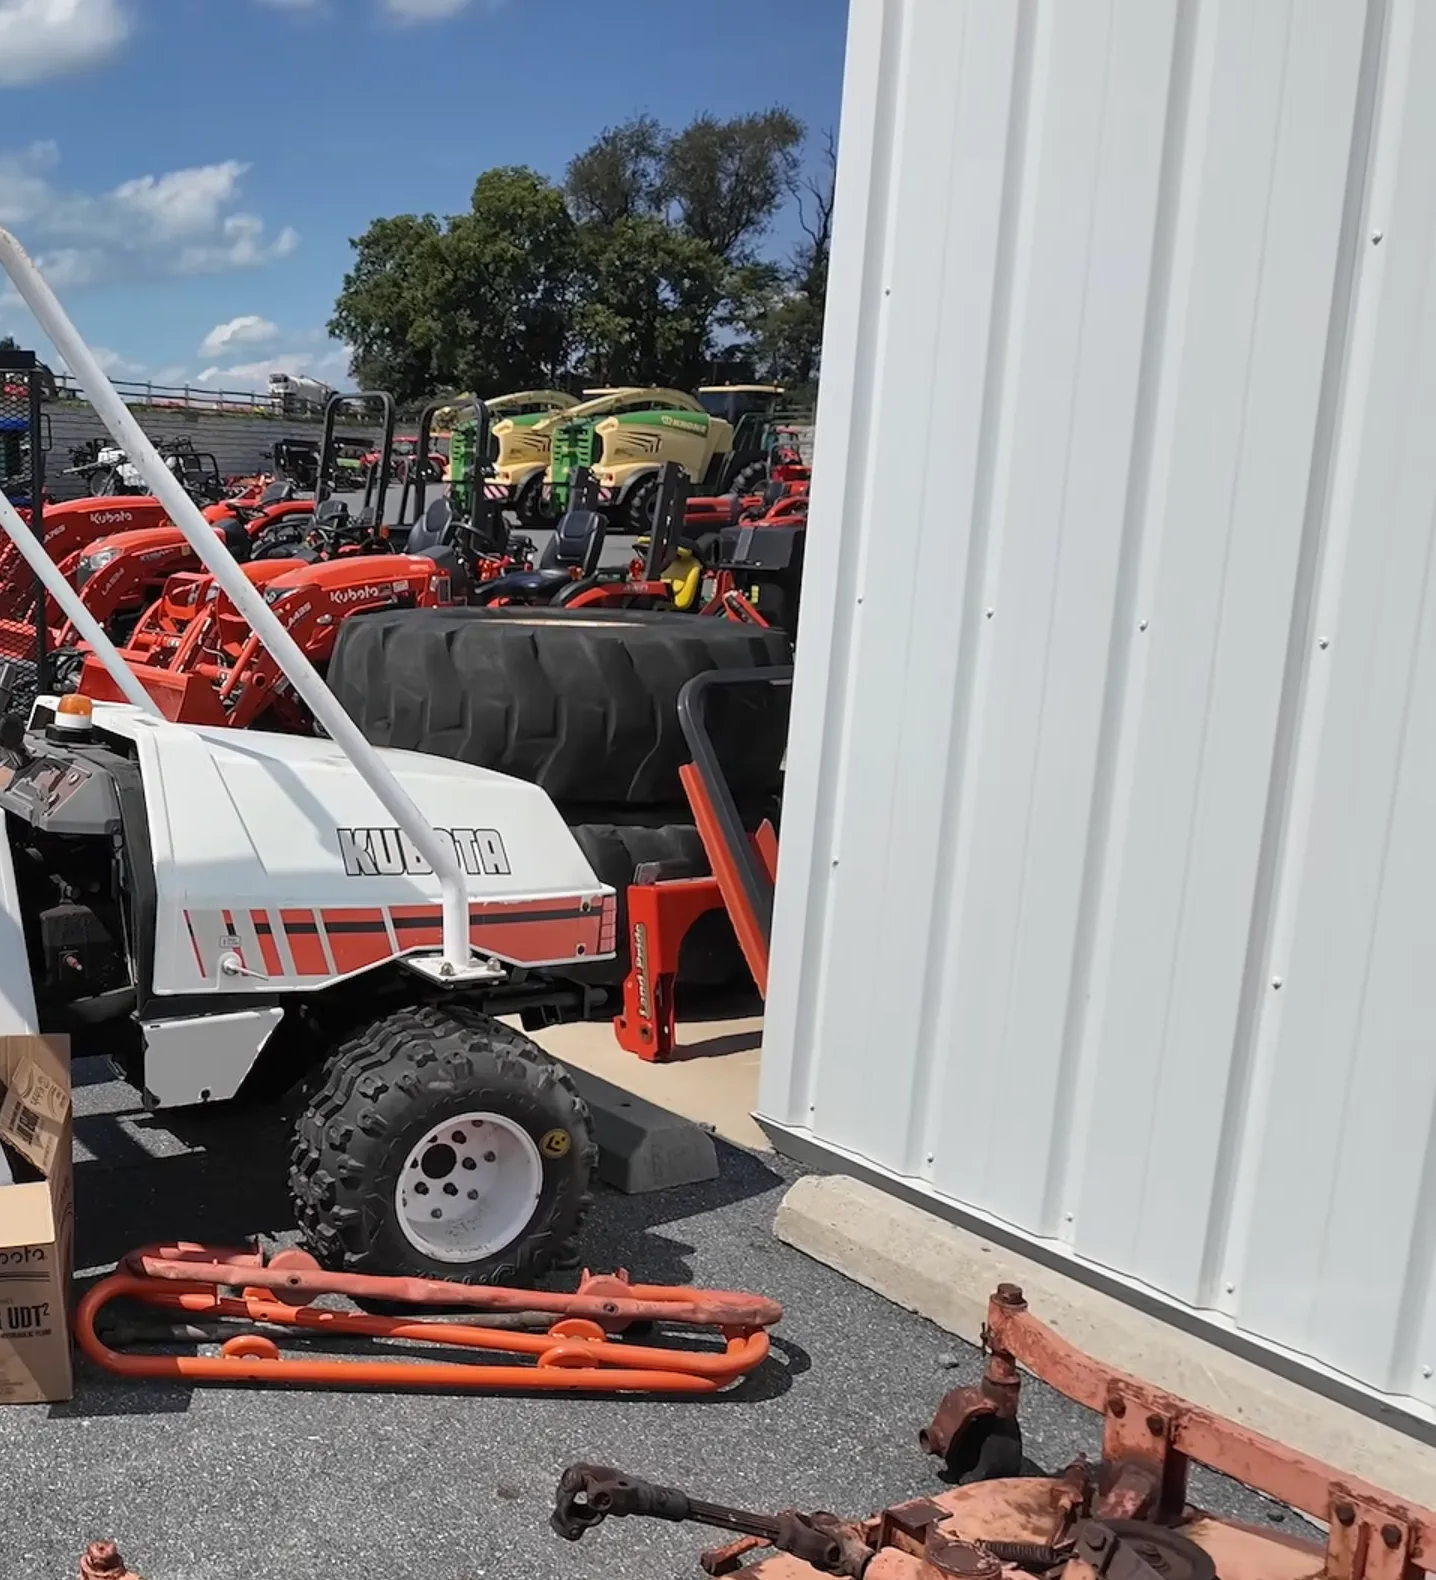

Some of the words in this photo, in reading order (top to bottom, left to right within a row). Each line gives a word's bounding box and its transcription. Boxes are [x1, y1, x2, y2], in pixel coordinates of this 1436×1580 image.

[90, 511, 133, 524] Kubota
[330, 585, 379, 604] Kubota
[337, 827, 511, 877] KUBTA
